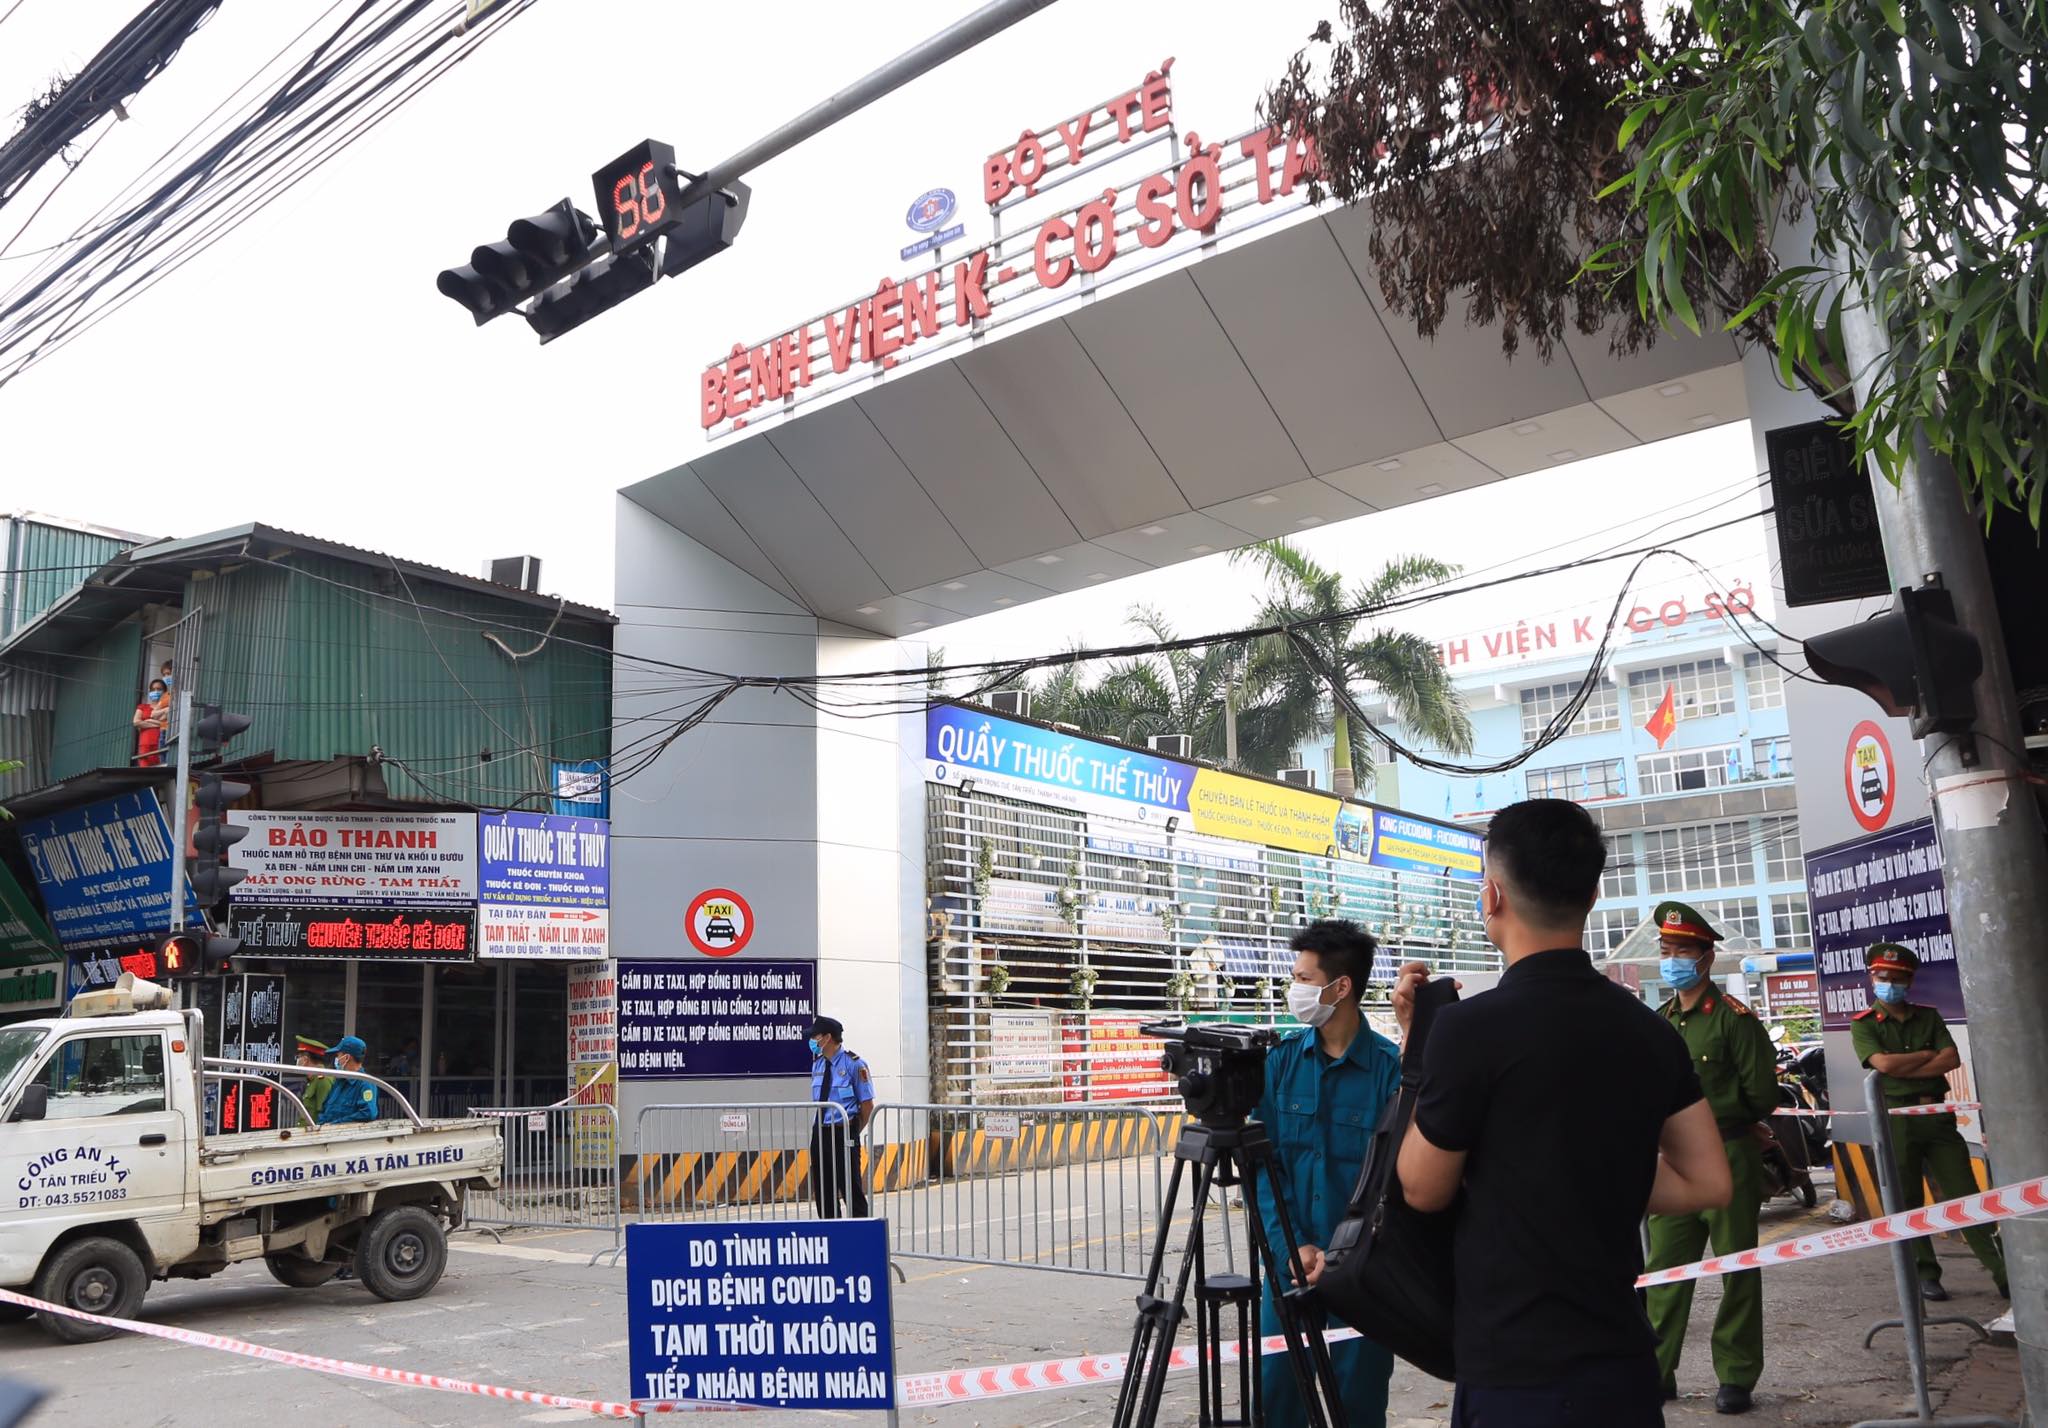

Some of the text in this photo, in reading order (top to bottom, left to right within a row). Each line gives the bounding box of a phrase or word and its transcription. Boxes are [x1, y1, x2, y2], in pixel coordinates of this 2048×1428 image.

[984, 56, 1176, 205] BỘ Y TẾ
[701, 342, 813, 430] BỆNH
[823, 276, 941, 369] VIỆN
[954, 250, 993, 327] K
[1034, 187, 1118, 289] CƠ
[1136, 131, 1225, 248] SỞ
[1482, 577, 1755, 659] VIỆN K CƠ SỞ
[938, 722, 1007, 769] QUẦY
[1012, 743, 1085, 786] THUỐC
[1090, 757, 1131, 795] THẾ
[1132, 766, 1181, 806] THỦY
[1858, 746, 1876, 764] TAXI
[269, 823, 436, 848] BẢO THANH
[1380, 816, 1397, 832] KING
[484, 814, 606, 868] QUẦY THUỐC THẾ THỦY
[242, 849, 269, 858] THUỐC
[272, 851, 292, 859] NAM
[295, 848, 308, 859] HỖ
[310, 851, 327, 861] TRỢ
[328, 850, 352, 861] BỆNH
[355, 852, 372, 860] UNG
[375, 852, 393, 861] THƯ
[395, 850, 405, 861] VÀ
[409, 851, 429, 861] KHỐI
[432, 853, 437, 861] U
[265, 862, 440, 874] XẠ ĐEN NẤM LINH CHI NẤM LIM XANH
[507, 867, 584, 880] THUỐC CHUYÊN KHOA
[245, 874, 461, 888] MẬT ONG RỪNG TAM THẤT
[707, 906, 731, 915] TAXI
[1908, 898, 1913, 920] 2
[485, 920, 605, 944] TAM THẤT NẤM LIM XANH
[569, 975, 614, 1000] THUỐC NAM
[622, 969, 802, 993] CẤM ĐI XE TAXI, HỢP ĐỒNG ĐI VÀO CỔNG NÀY.
[1780, 979, 1808, 990] LỐI VÀO
[569, 1010, 614, 1027] TAM THẤT
[622, 1001, 632, 1015] XE
[635, 1001, 655, 1017] TAXI,
[658, 999, 674, 1018] HỢP
[677, 995, 699, 1015] ĐỒNG
[701, 1001, 709, 1015] ĐI
[712, 997, 727, 1015] VÀO
[730, 995, 752, 1015] CỔNG
[754, 1001, 759, 1015] 2
[762, 1000, 777, 1015] CHU
[779, 997, 796, 1015] VĂN
[798, 1000, 811, 1015] AN.
[622, 1021, 802, 1045] CẤM ĐI XE TAXI, HỢP ĐỒNG KHÔNG CÓ KHÁCH
[621, 1049, 685, 1071] VÀO BỆNH VIỆN.
[19, 1148, 67, 1191] CÔNG
[75, 1146, 101, 1162] AN
[252, 1144, 463, 1185] CÔNG AN XÃ TÂN TRIỀU
[39, 1174, 66, 1188] TÂN
[19, 1188, 126, 1208] ĐT: 043.5521083
[690, 1232, 828, 1267] DO TÌNH HÌNH
[652, 1273, 872, 1312] DỊCH BỆNH COVID-19
[651, 1316, 877, 1362] TẠM THỜI KHÔNG
[646, 1365, 690, 1400] TIẾP
[697, 1367, 755, 1403] NHẬN
[761, 1367, 818, 1405] BỆNH
[825, 1366, 885, 1399] NHÂN
